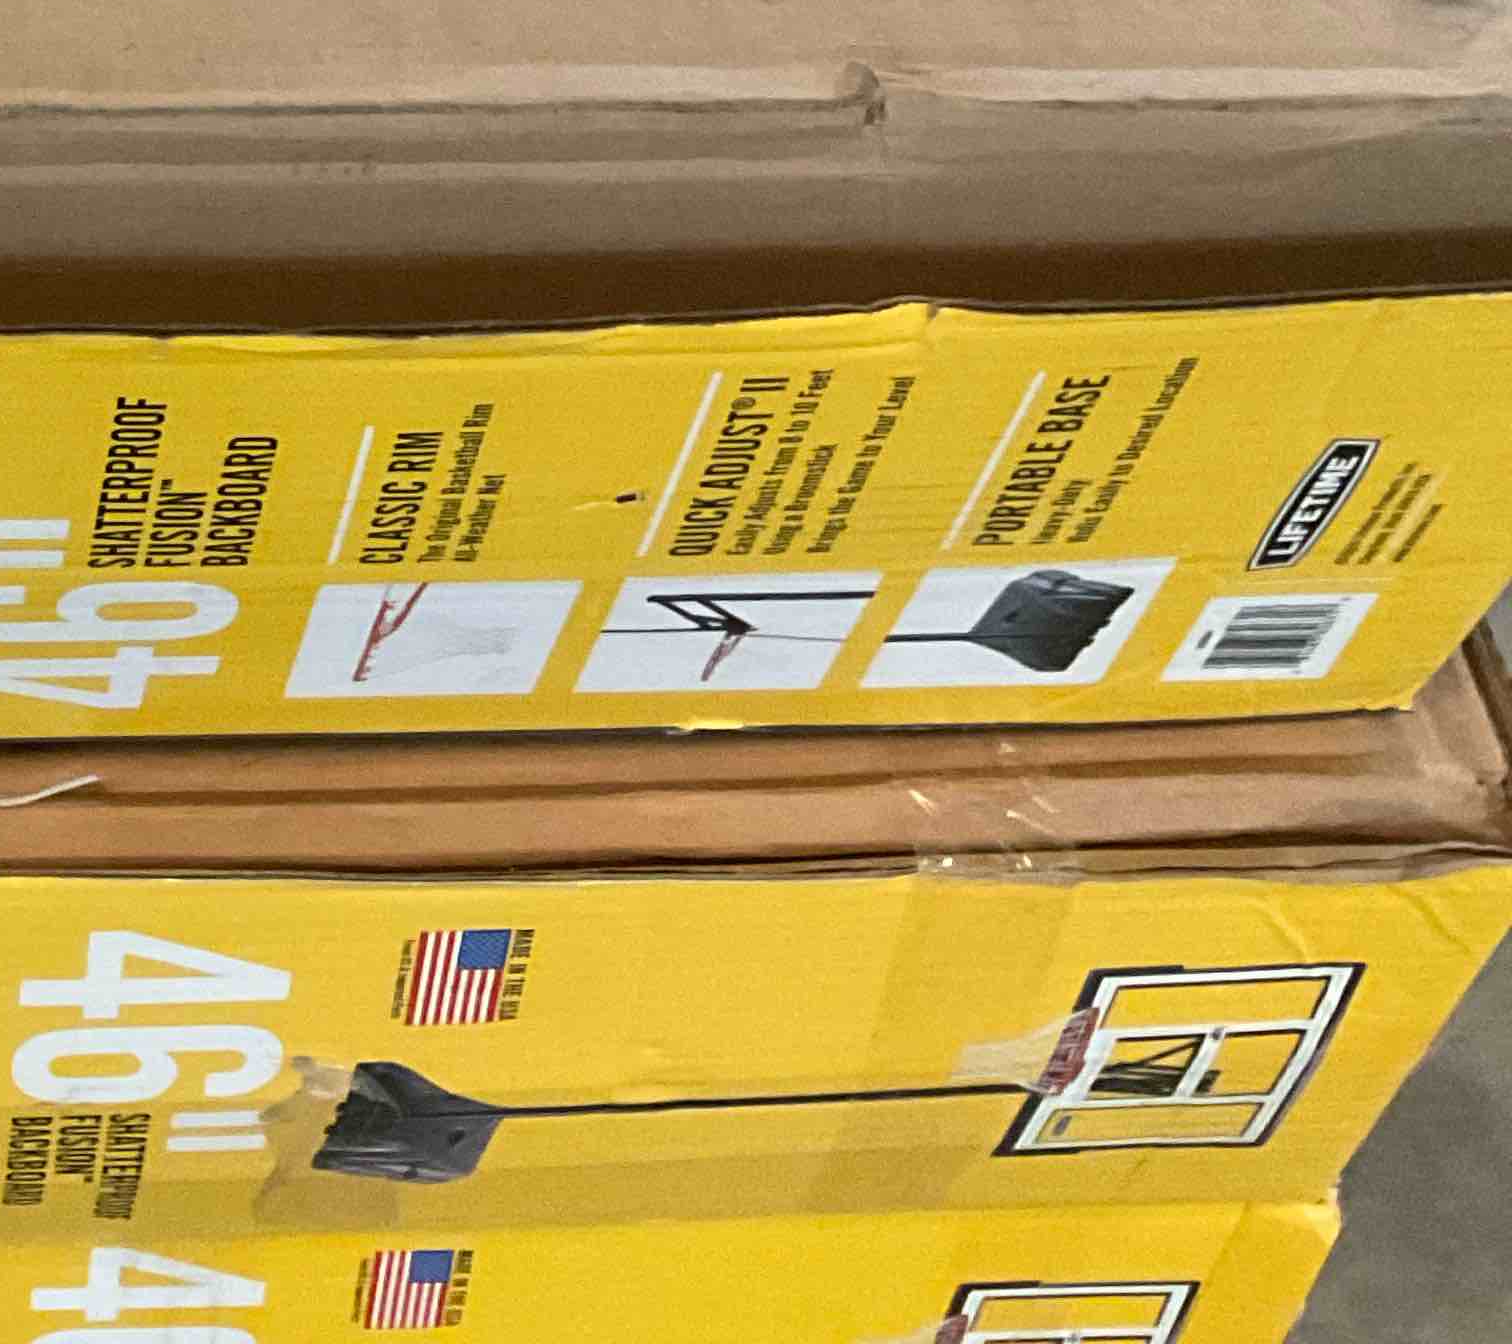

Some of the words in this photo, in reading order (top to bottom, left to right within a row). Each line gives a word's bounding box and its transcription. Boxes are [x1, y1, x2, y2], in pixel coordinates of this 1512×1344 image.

[461, 403, 494, 427] Rim
[797, 369, 834, 398] Feet
[1147, 357, 1199, 410] Location
[386, 432, 443, 472] RIM
[442, 431, 486, 494] Basketball
[668, 496, 736, 557] QUICK
[740, 376, 791, 393] II
[836, 461, 875, 493] Game
[877, 376, 915, 409] Level
[972, 439, 1074, 545] PORTABLE
[1038, 375, 1111, 432] BASE
[89, 396, 168, 570] SHATTERPROOF
[200, 435, 279, 569] BACKBOARD
[357, 480, 428, 563] CLASSIC
[425, 498, 463, 541] Original
[1266, 453, 1362, 558] LIFETIME
[2, 1116, 53, 1206] BACKBOARD
[29, 1246, 266, 1344] 4
